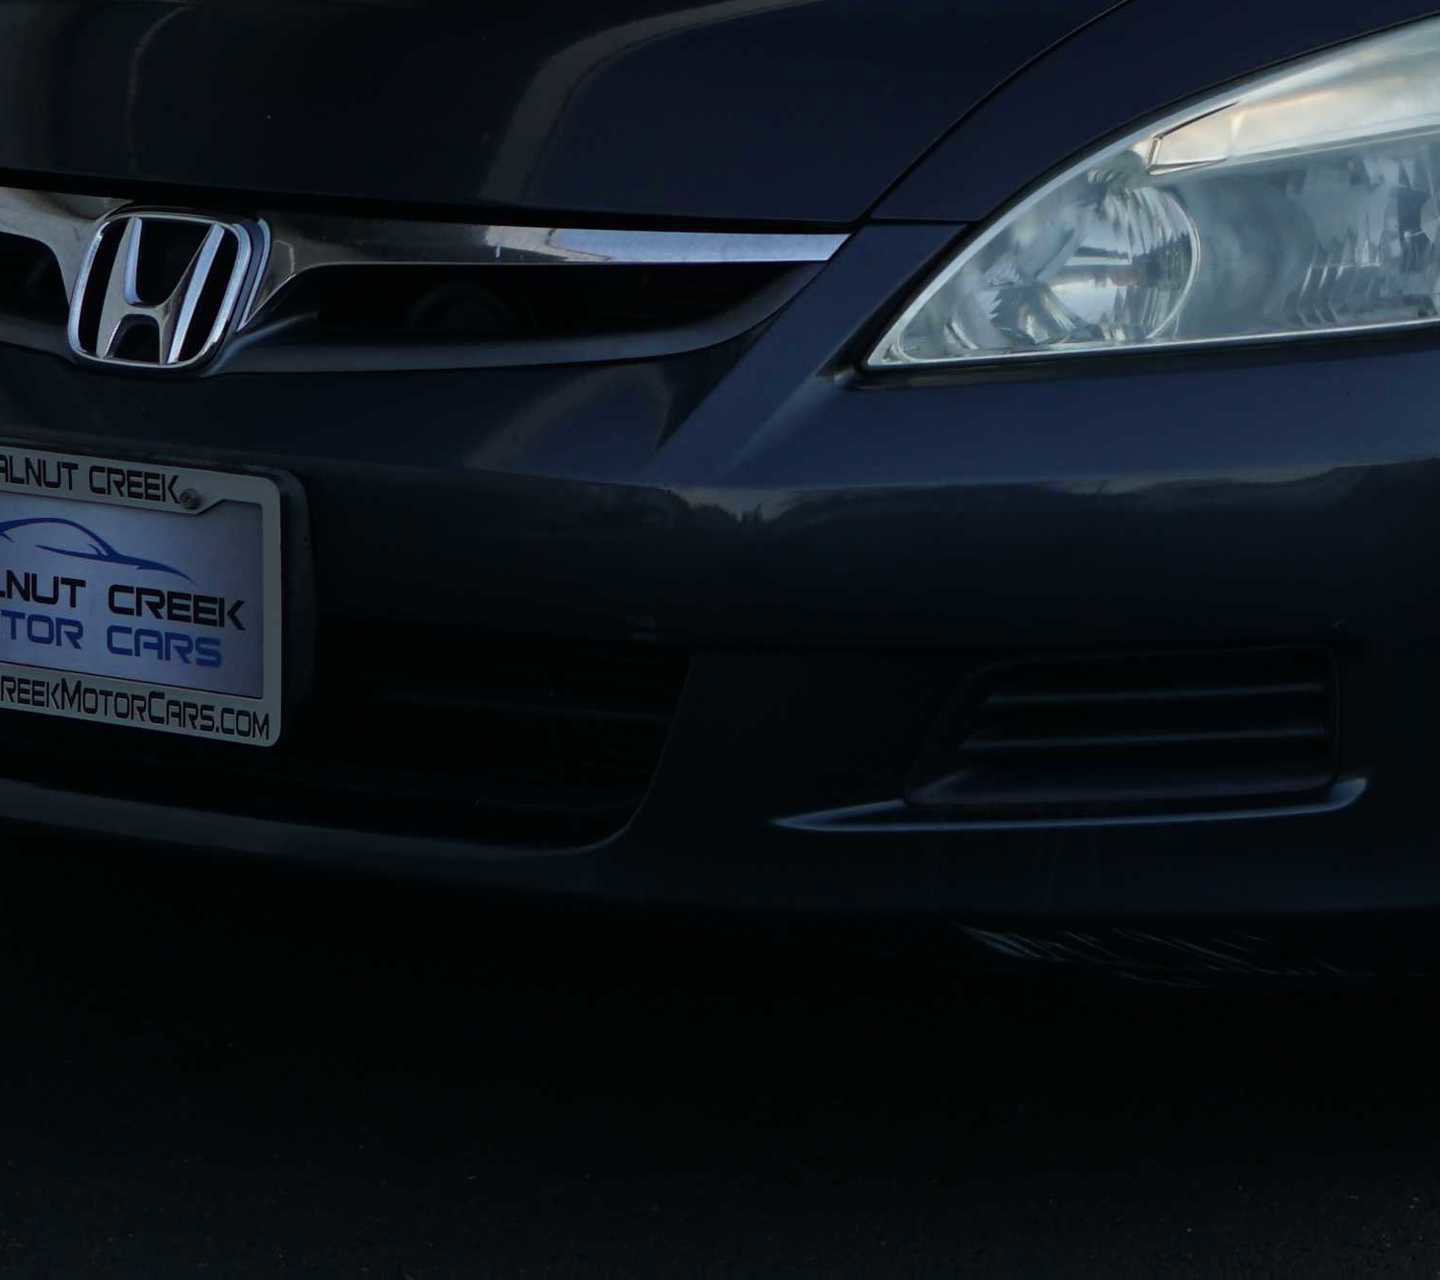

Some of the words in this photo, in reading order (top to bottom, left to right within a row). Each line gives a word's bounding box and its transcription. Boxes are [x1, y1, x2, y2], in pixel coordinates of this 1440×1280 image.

[88, 466, 180, 504] CREEK
[107, 584, 246, 630] CREEK
[106, 626, 222, 668] CARS
